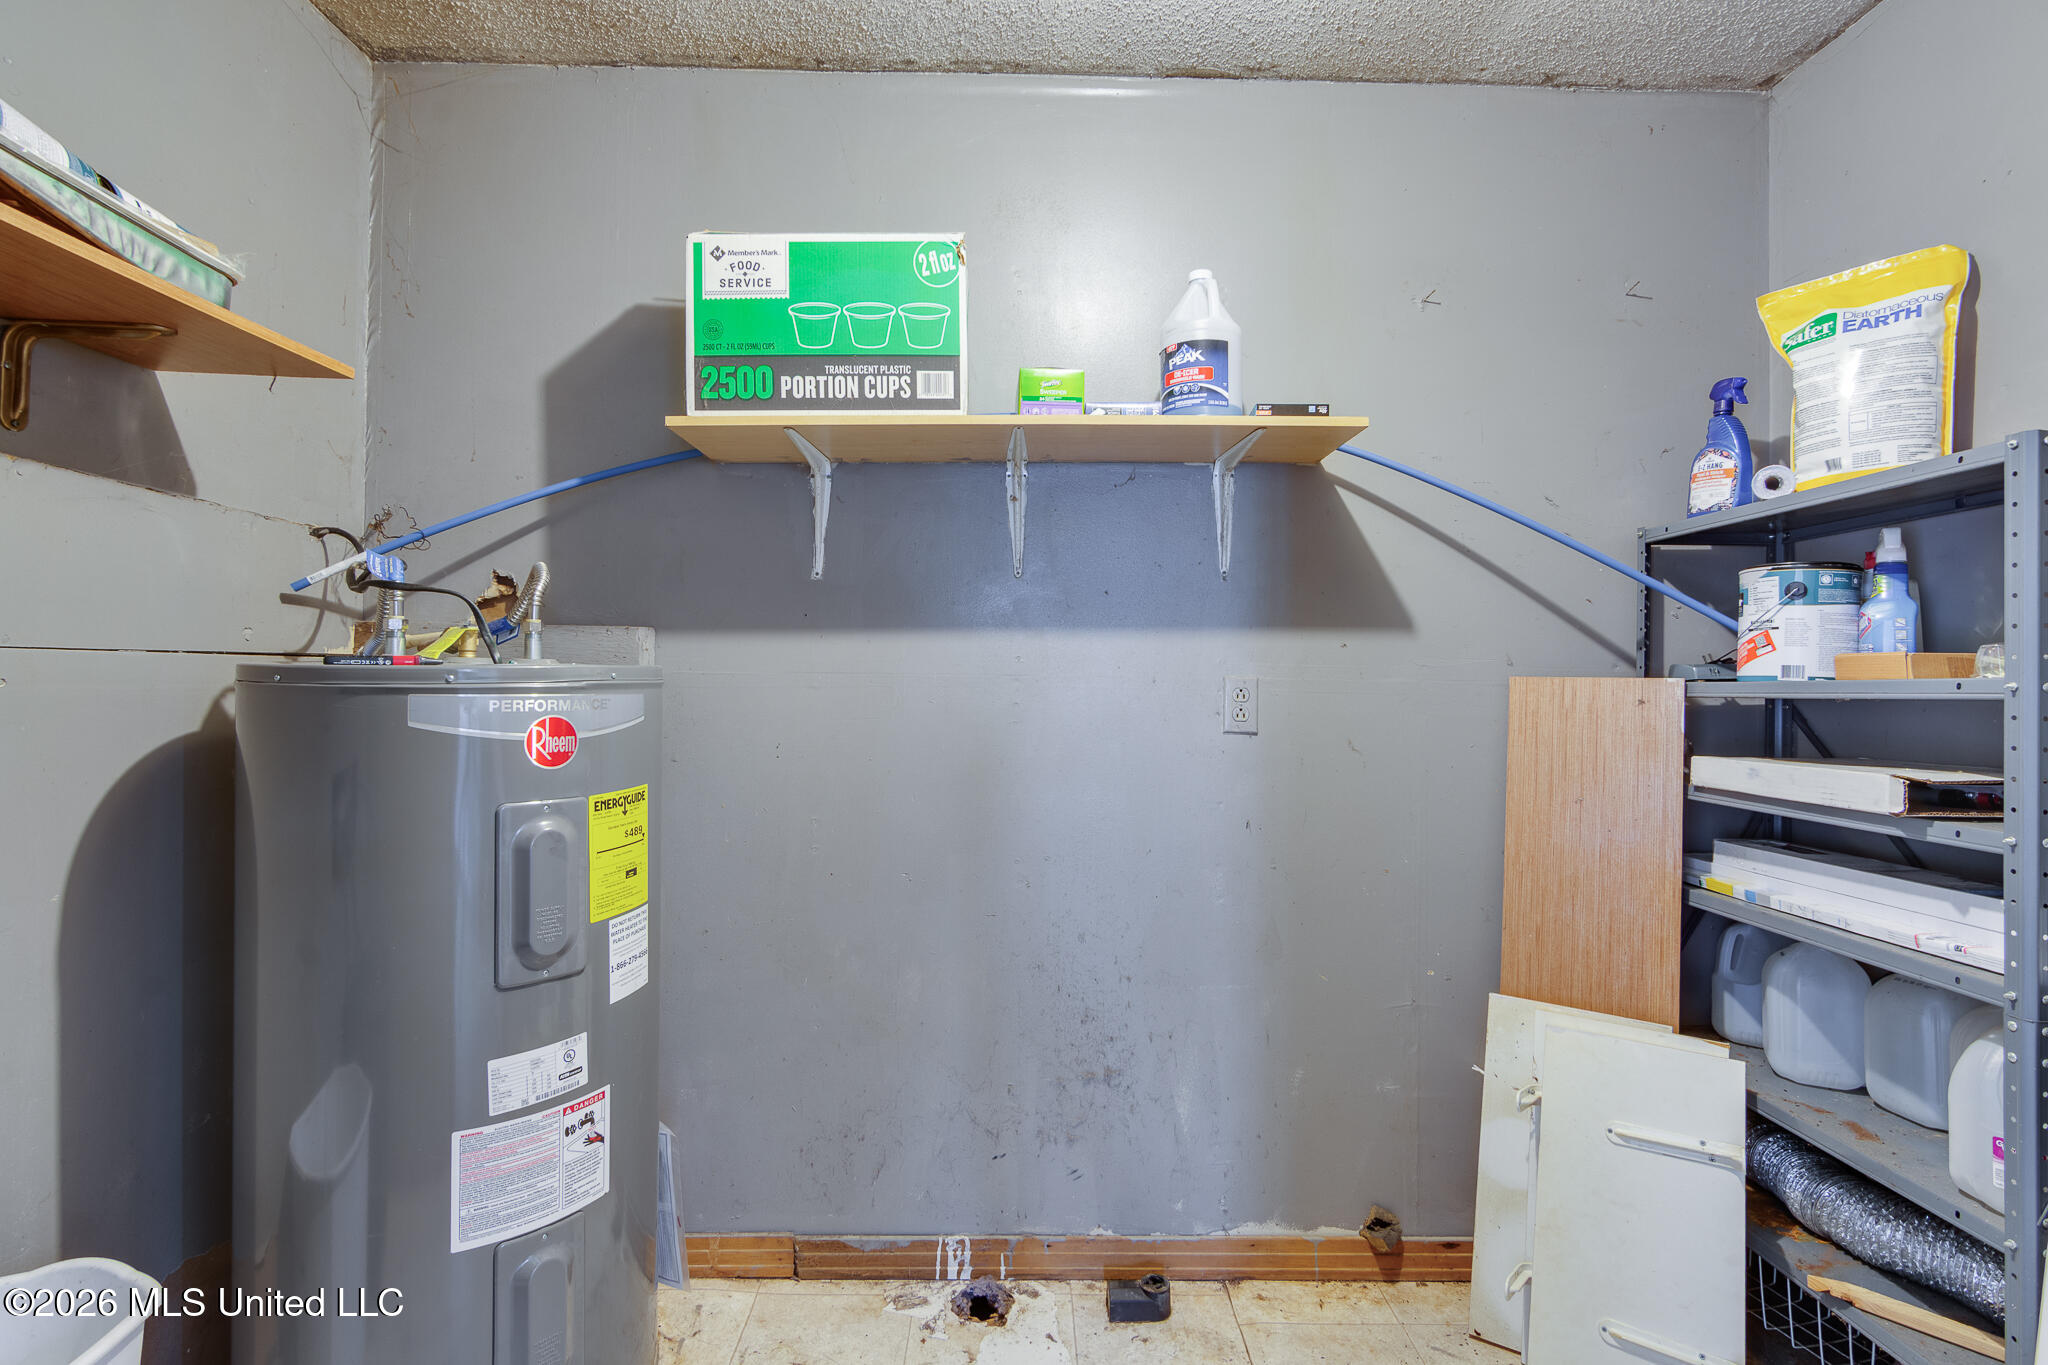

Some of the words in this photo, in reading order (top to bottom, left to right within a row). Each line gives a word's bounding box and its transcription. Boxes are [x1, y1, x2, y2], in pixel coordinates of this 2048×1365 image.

[727, 249, 760, 257] Member's
[761, 249, 779, 257] Mark
[729, 260, 761, 272] FOOD
[918, 253, 930, 277] 2
[929, 250, 941, 274] fl
[940, 252, 957, 272] oz
[719, 277, 772, 288] SERVICE
[1842, 292, 1944, 320] Diatomaceous
[1842, 303, 1922, 333] EARTH
[702, 343, 715, 351] 2500
[824, 365, 878, 374] TRANSLUCENT
[879, 365, 912, 374] PLASTIC
[1168, 350, 1206, 371] PEAK
[700, 364, 775, 400] 2500
[780, 375, 859, 399] PORTION
[864, 375, 912, 399] CUPS
[488, 698, 609, 713] PERFORMANCE
[531, 717, 576, 760] Rheem
[594, 790, 646, 813] ENERGYGUIDE
[624, 824, 643, 838] $489
[572, 1093, 604, 1112] DANGER
